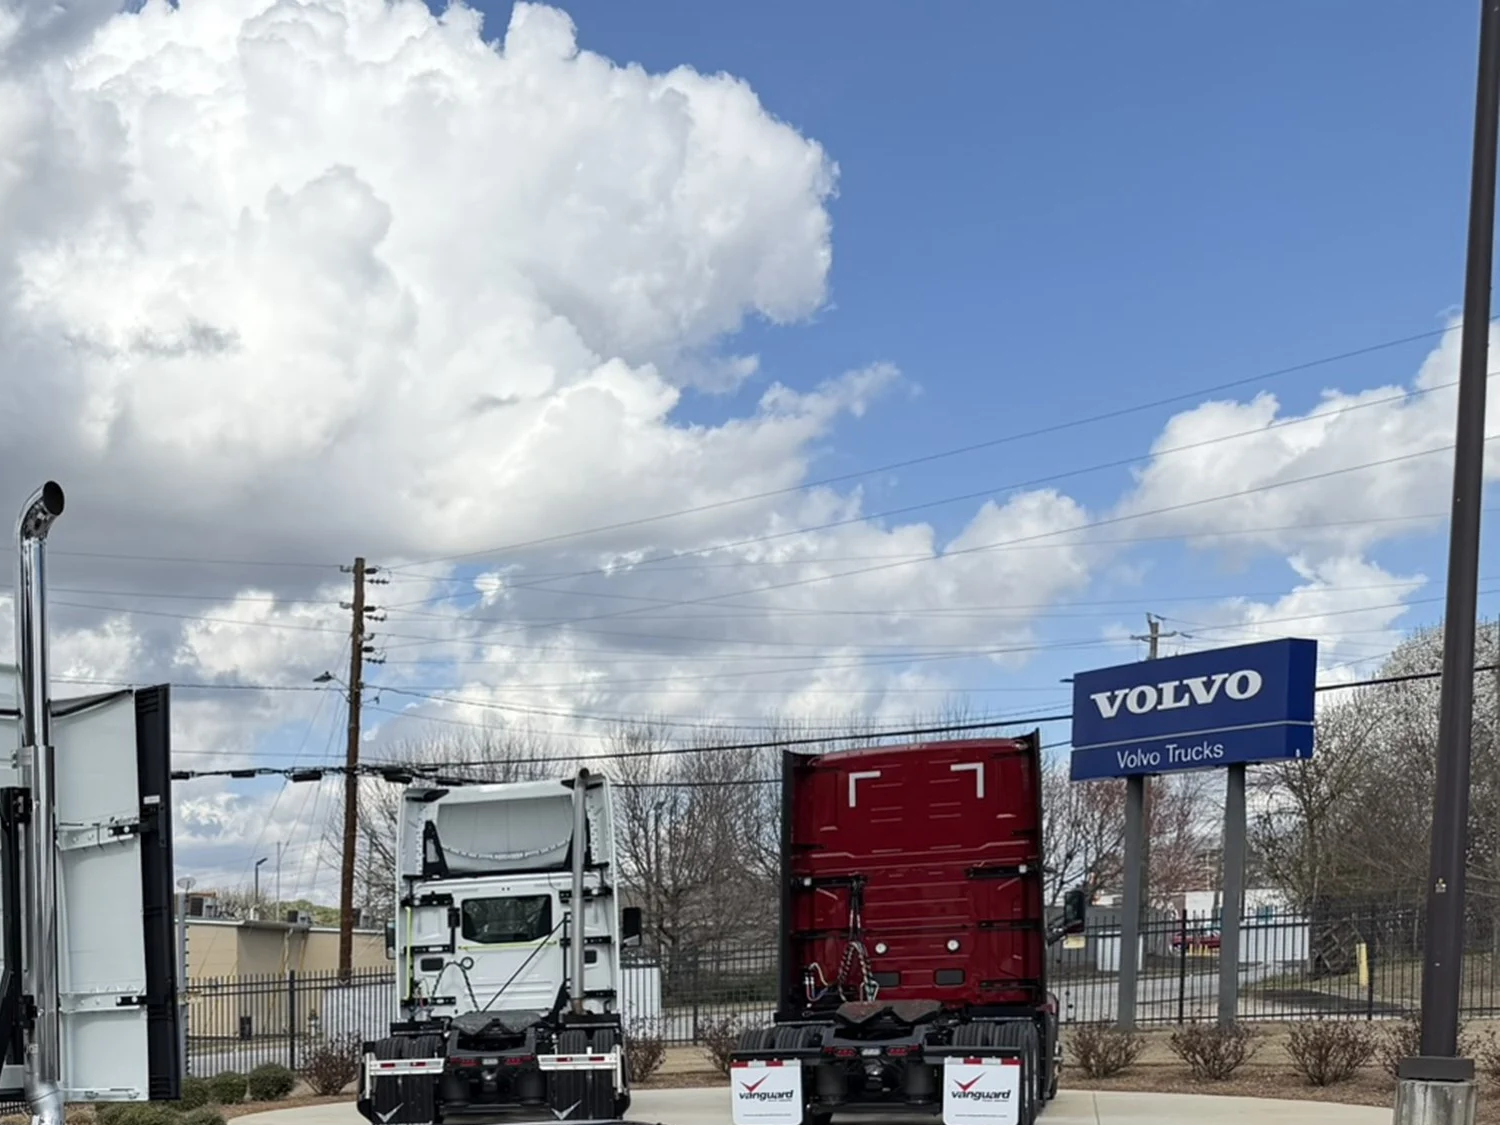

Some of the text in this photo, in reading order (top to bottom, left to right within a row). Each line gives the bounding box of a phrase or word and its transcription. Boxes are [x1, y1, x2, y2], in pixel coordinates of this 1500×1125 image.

[1090, 669, 1262, 719] VOLVO
[1116, 741, 1224, 770] Volvo Trucks
[739, 1089, 794, 1102] vanguard
[951, 1089, 1012, 1101] vanguard
